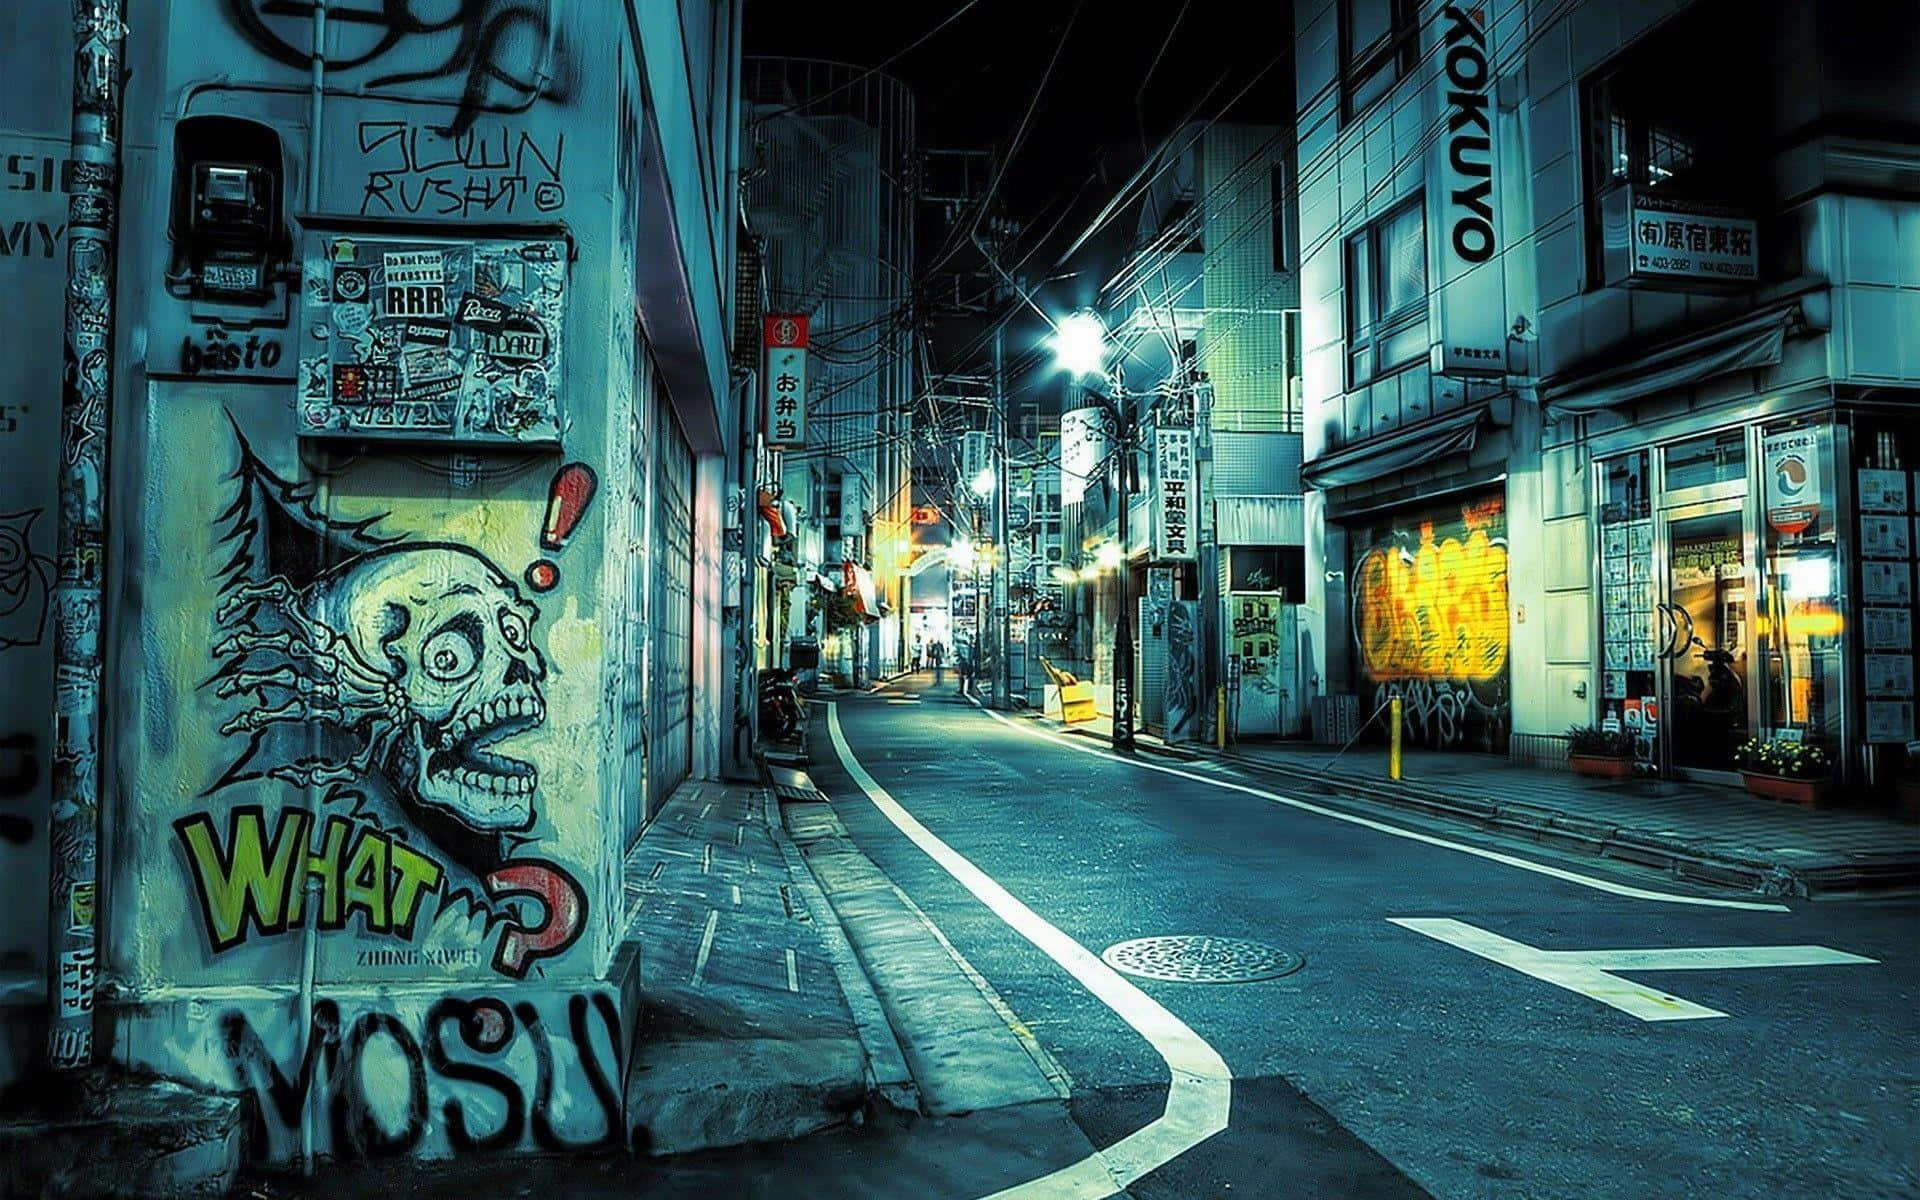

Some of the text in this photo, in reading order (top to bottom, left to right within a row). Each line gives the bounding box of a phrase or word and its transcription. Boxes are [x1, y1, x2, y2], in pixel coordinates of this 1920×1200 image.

[387, 285, 444, 315] RRR
[776, 373, 799, 440] お弁当
